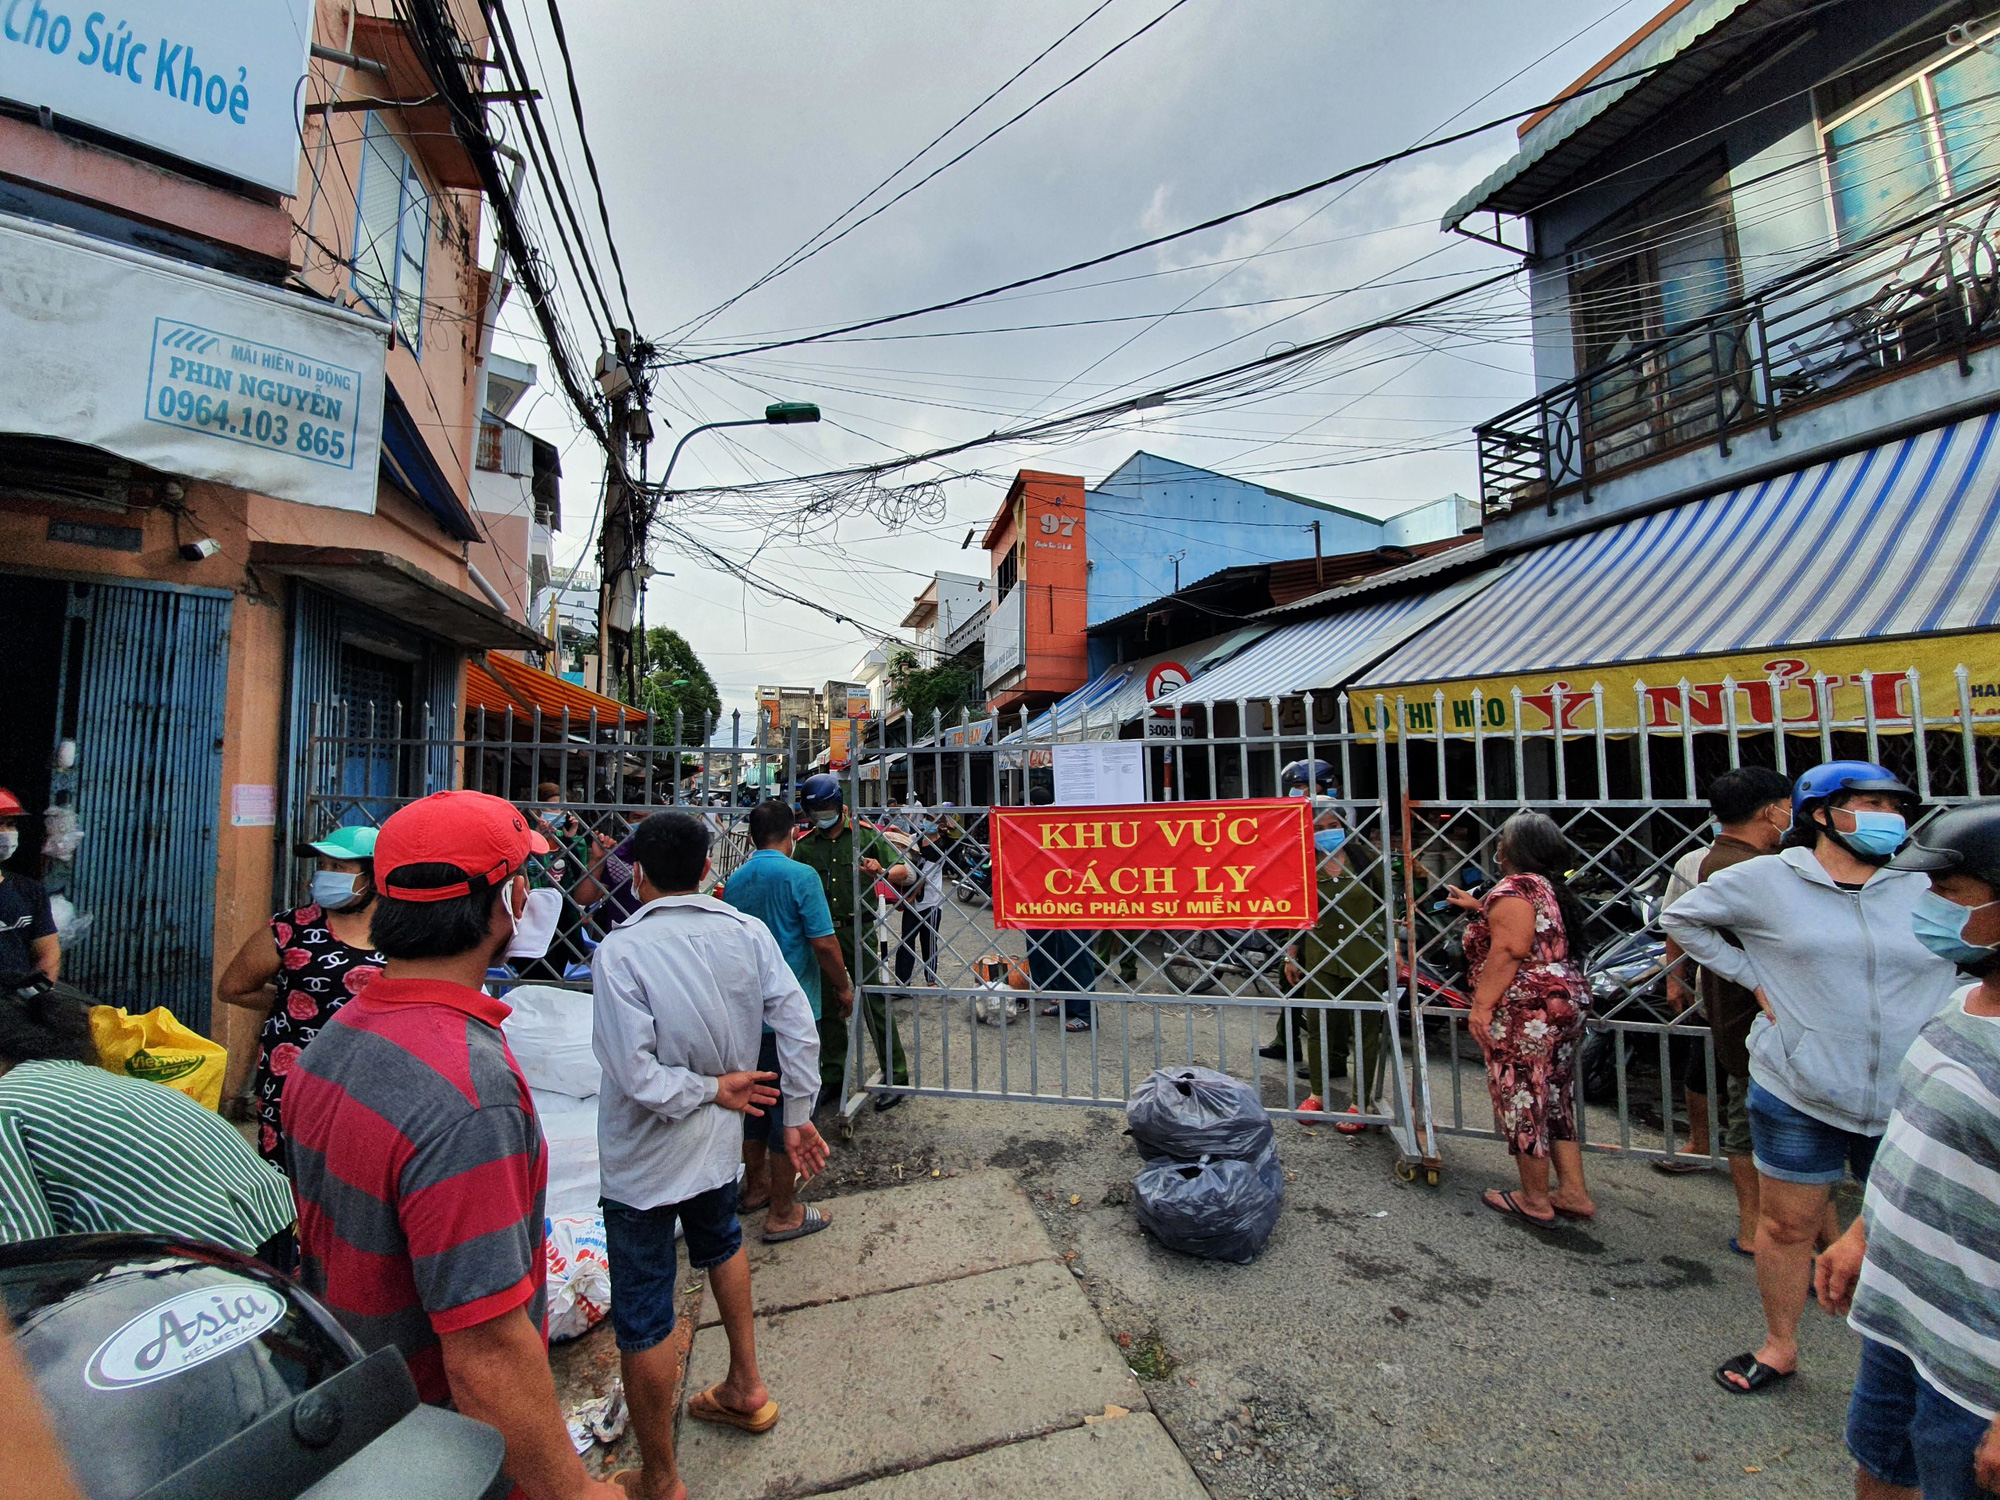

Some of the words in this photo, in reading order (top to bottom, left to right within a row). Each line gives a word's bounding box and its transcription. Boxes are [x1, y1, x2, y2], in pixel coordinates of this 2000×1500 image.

[4, 0, 71, 55] Cho
[77, 11, 147, 84] Sức
[154, 38, 250, 125] Khoẻ
[231, 343, 258, 365] MÁI
[261, 352, 294, 374] HIÊN
[298, 361, 312, 379] DI
[316, 367, 351, 391] ĐỘNG
[169, 356, 233, 392] PHIN
[238, 373, 343, 422] NGUYỄN
[158, 385, 289, 446] 0964.103
[296, 421, 346, 460] 865
[1040, 513, 1079, 537] 97
[1971, 683, 2000, 698] HA
[1395, 701, 1444, 734] HỊ
[1452, 697, 1506, 728] HEO
[1038, 821, 1142, 849] KHU
[1156, 812, 1259, 852] VỰC
[1044, 859, 1178, 895] CÁCH
[1193, 865, 1256, 893] LY
[1015, 899, 1084, 915] KHÔNG
[1089, 898, 1145, 917] PHẬN
[1151, 898, 1178, 917] SỰ
[1186, 895, 1241, 914] MIỄN
[1249, 897, 1292, 913] VÀO
[134, 1294, 267, 1371] Asia
